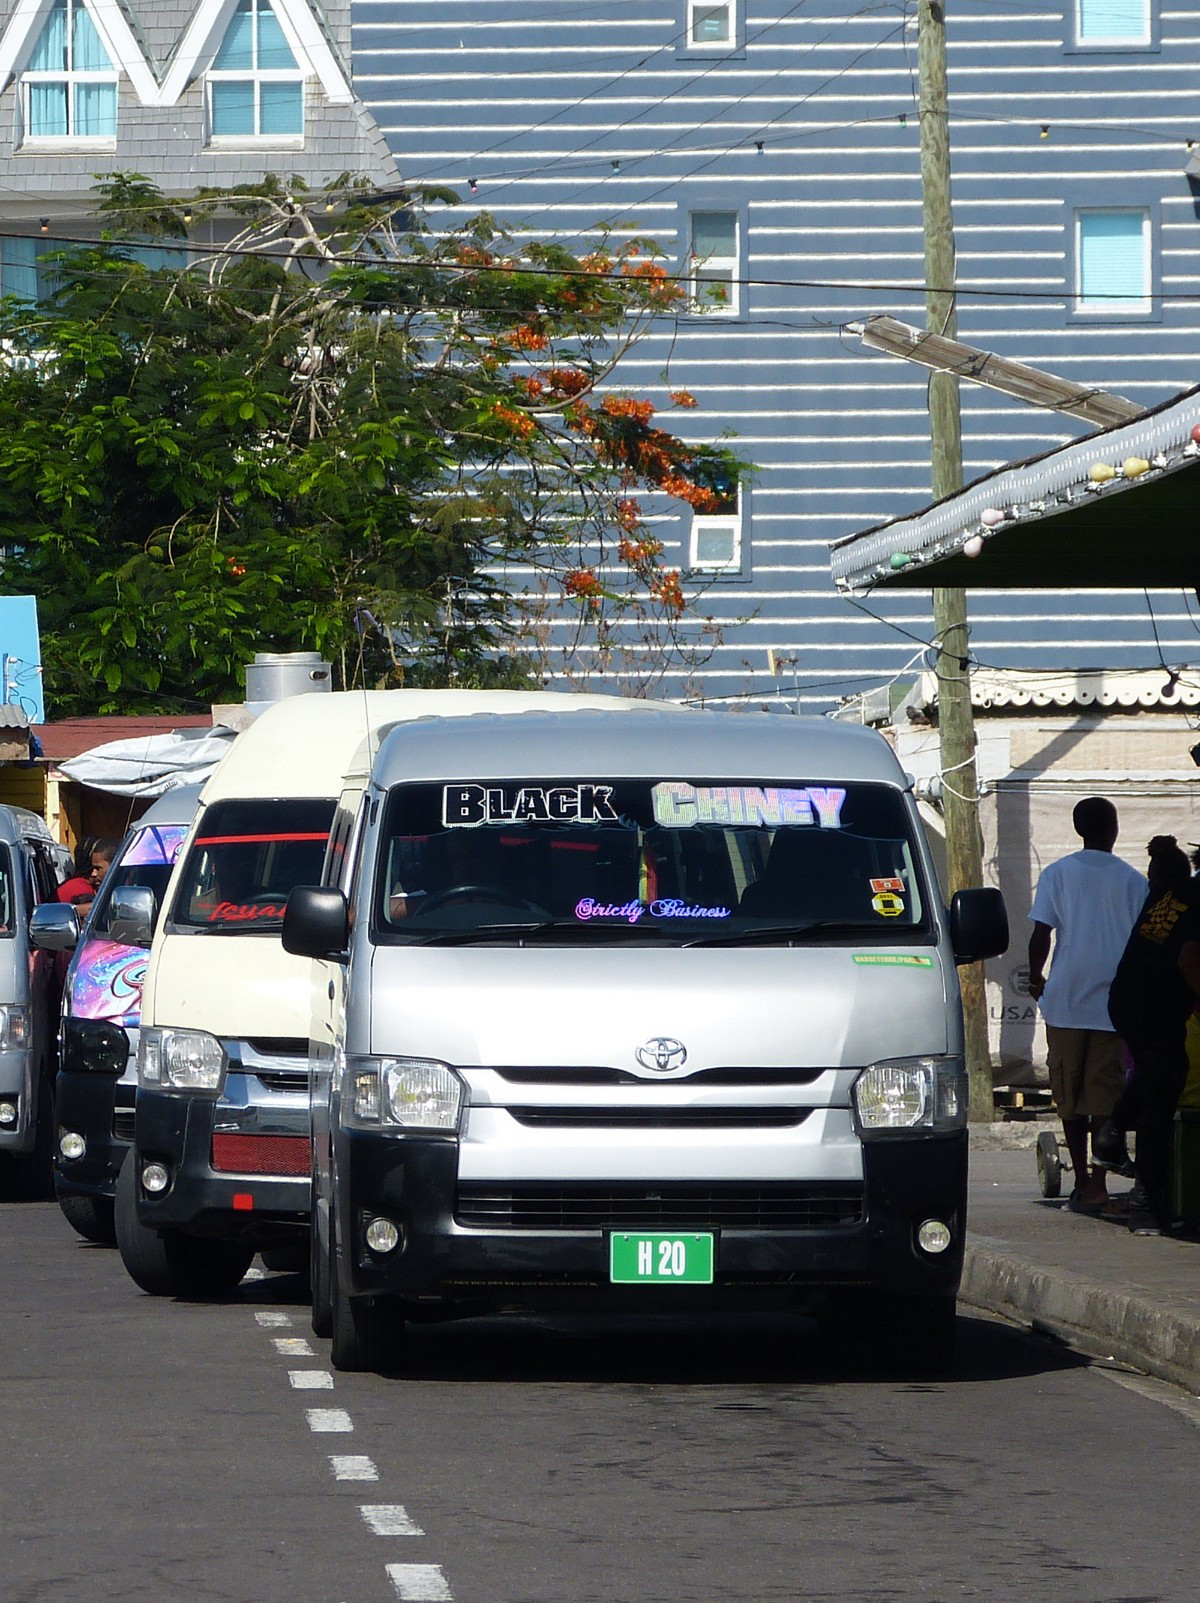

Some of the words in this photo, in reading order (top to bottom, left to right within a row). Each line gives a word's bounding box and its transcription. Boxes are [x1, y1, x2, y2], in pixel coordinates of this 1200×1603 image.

[442, 784, 617, 828] BLACK
[652, 782, 846, 828] CHINEY
[575, 898, 645, 923] Strictly
[650, 898, 731, 918] Business
[638, 1241, 653, 1275] H
[658, 1240, 686, 1276] 20
